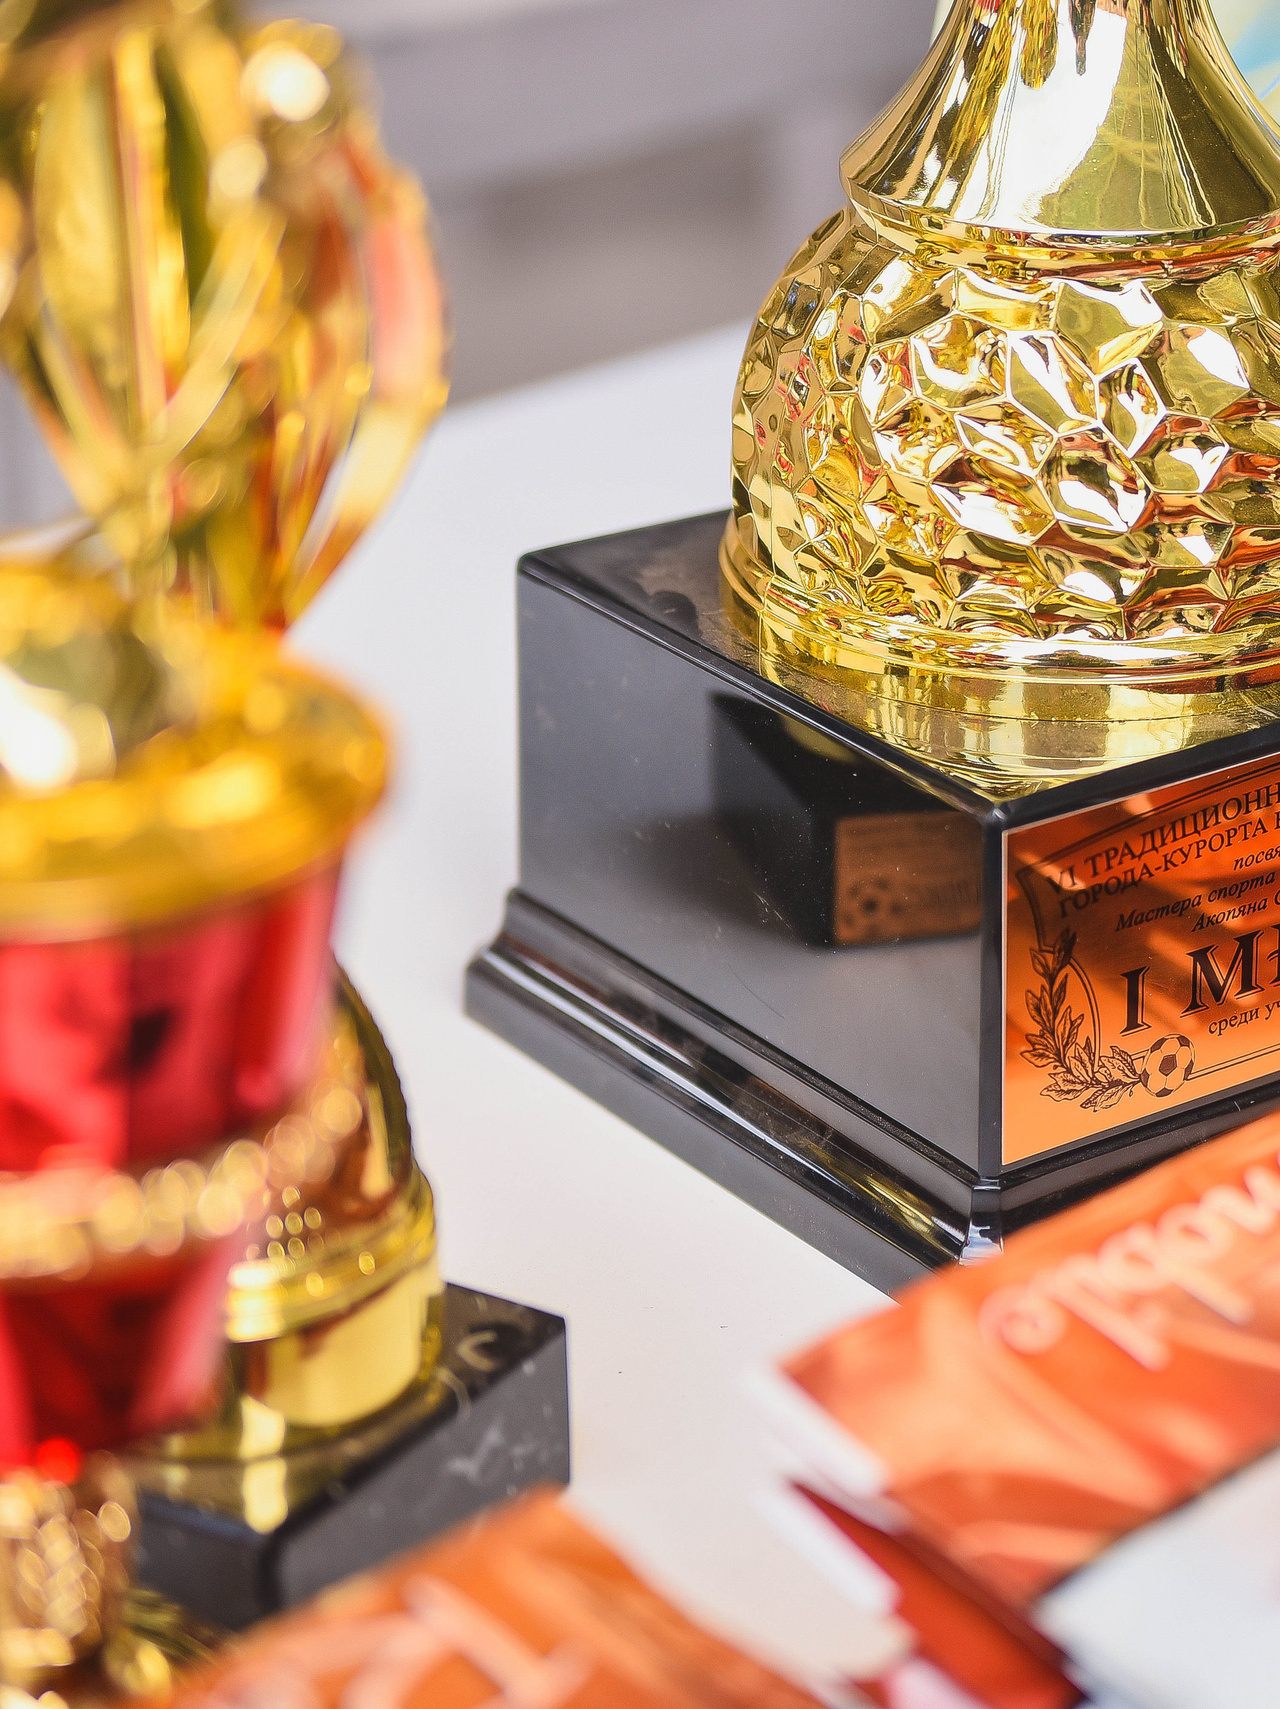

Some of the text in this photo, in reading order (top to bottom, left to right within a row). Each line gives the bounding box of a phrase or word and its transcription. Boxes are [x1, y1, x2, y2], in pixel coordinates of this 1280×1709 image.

[1057, 817, 1268, 918] ГОРОДА-КУРОРТА
[1115, 893, 1202, 933] Мастера
[1208, 871, 1276, 904] спорта
[1191, 898, 1268, 933] Акопяна
[1208, 1009, 1260, 1036] среди
